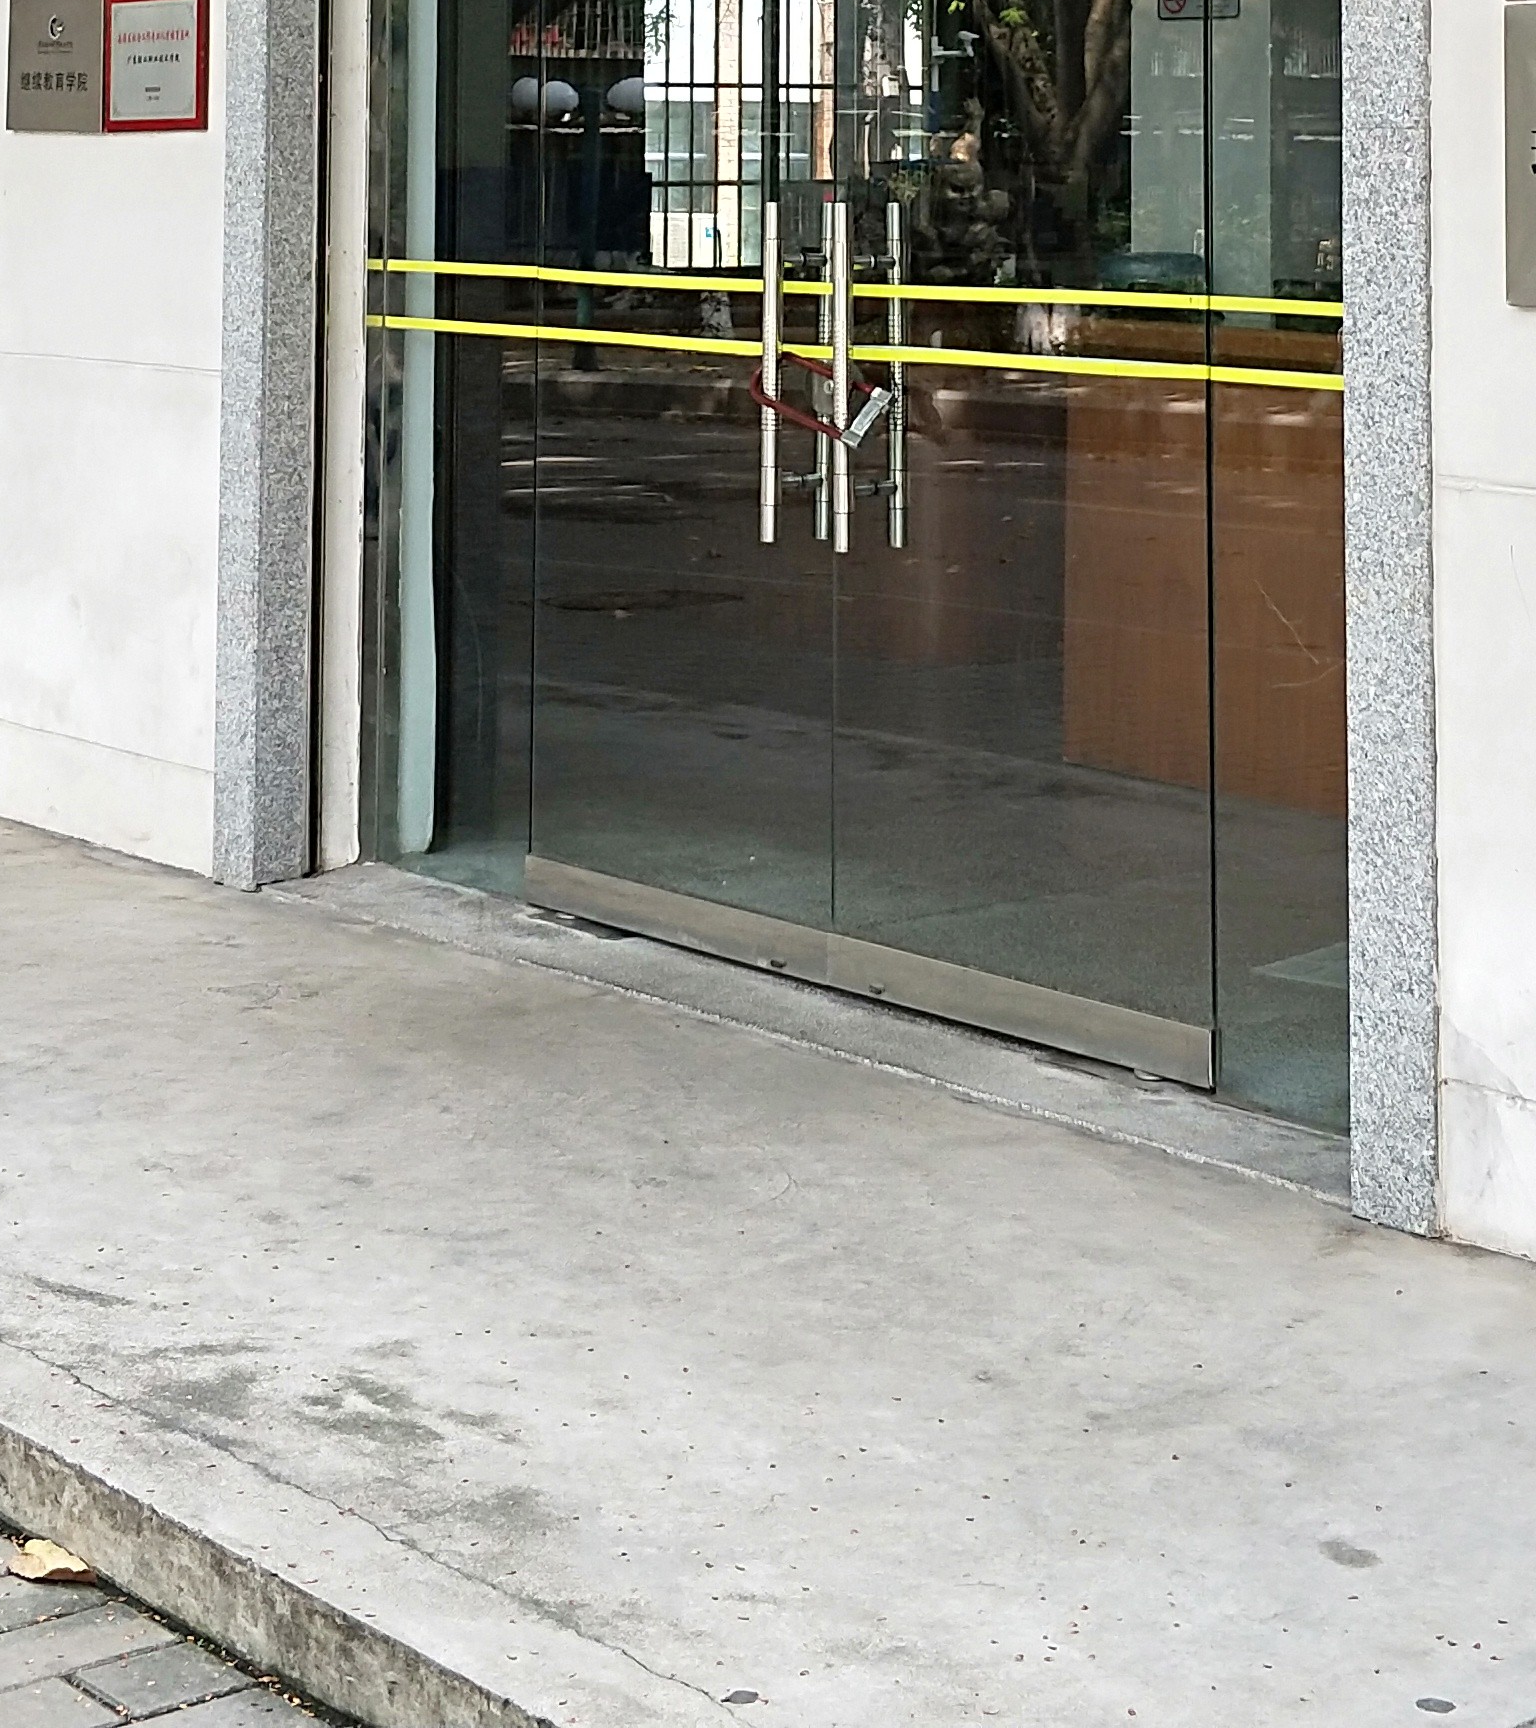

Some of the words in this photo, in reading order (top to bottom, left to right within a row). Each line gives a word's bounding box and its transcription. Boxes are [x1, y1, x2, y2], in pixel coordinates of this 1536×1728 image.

[20, 71, 89, 92] 继续教育学院
